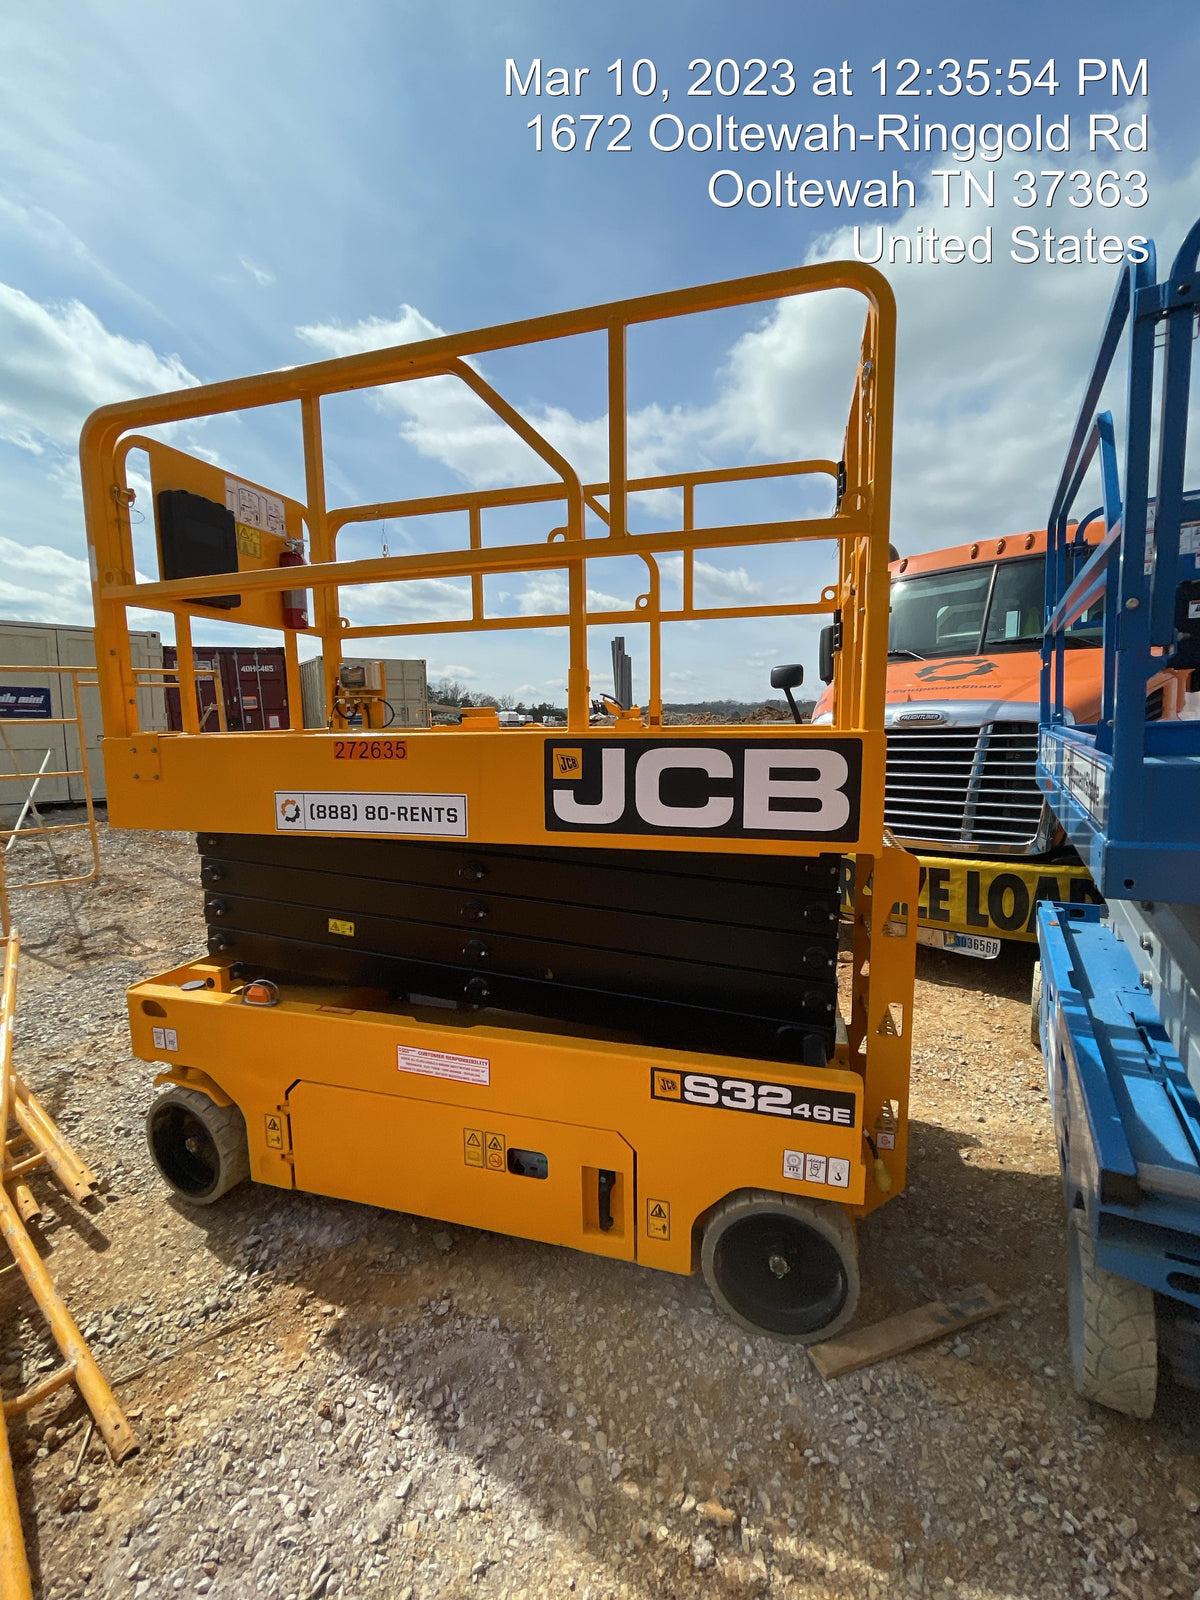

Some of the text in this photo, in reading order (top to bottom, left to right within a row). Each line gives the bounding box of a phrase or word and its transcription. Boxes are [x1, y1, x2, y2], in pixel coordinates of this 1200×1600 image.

[335, 741, 407, 759] 272635
[560, 755, 579, 771] JCB
[552, 747, 850, 832] JCB
[309, 803, 459, 824] (888) 80-RENTS
[660, 1078, 677, 1092] JCB
